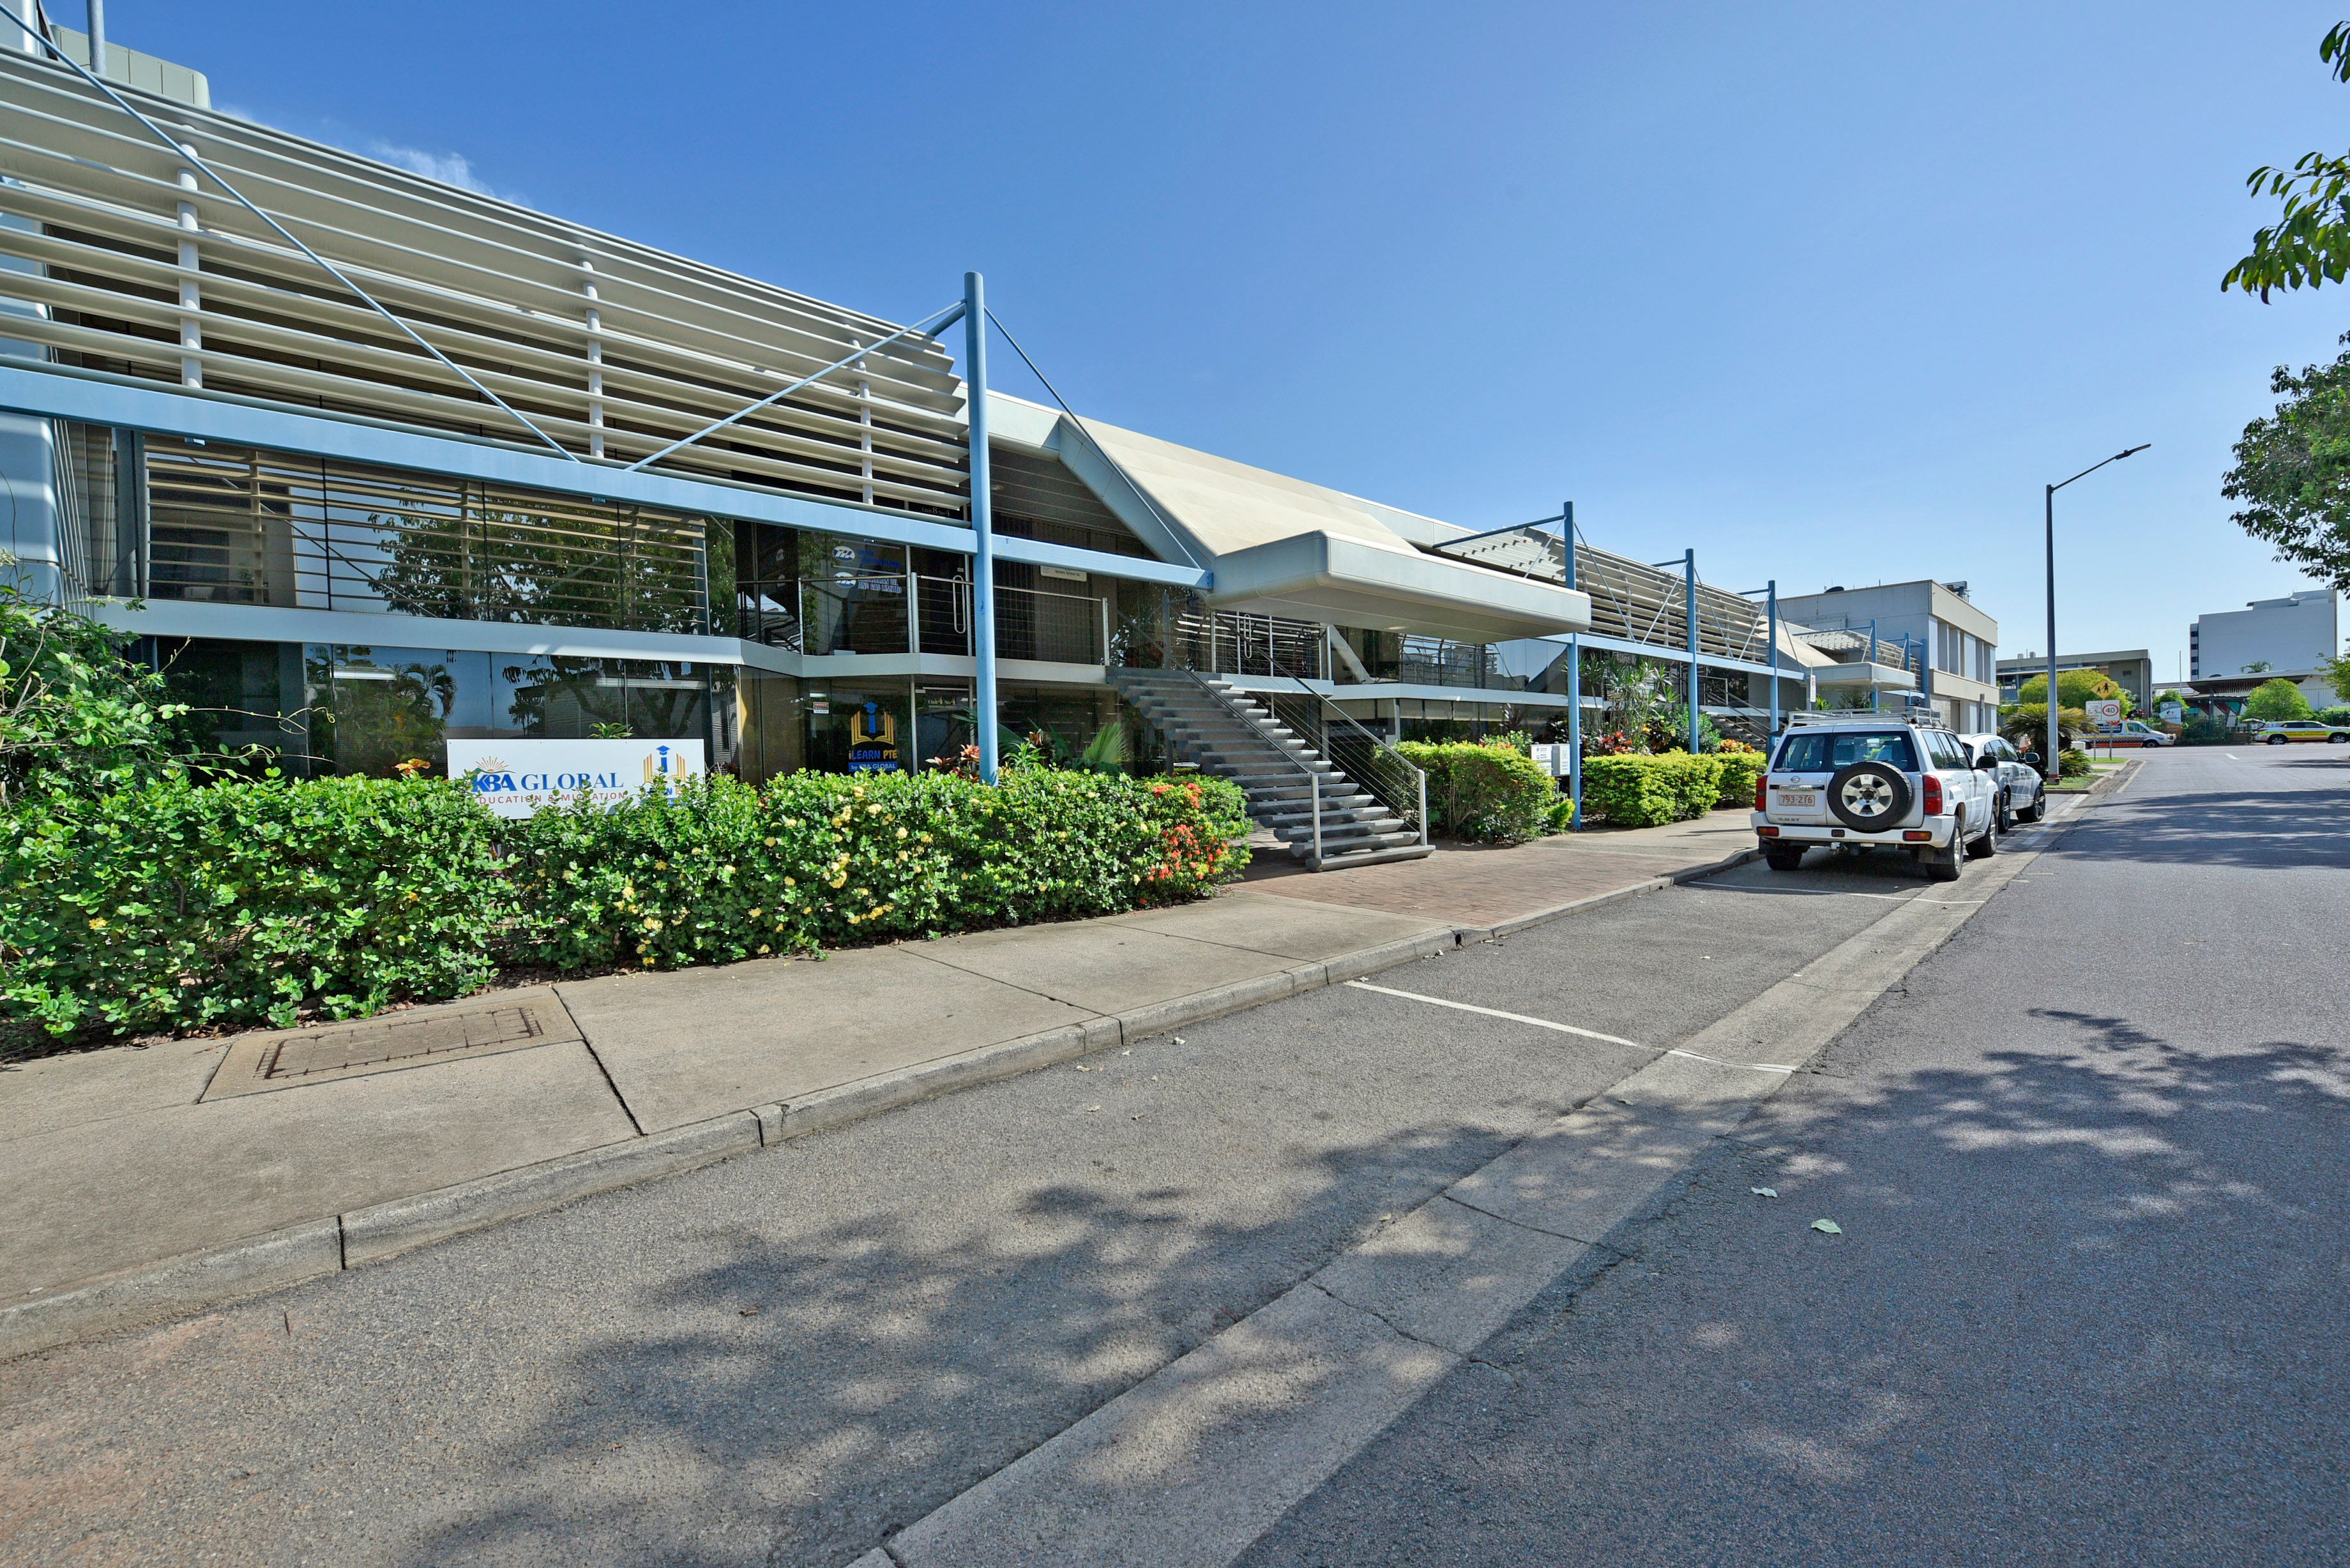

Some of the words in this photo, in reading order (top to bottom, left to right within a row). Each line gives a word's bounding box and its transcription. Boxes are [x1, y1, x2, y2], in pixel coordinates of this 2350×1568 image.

[932, 506, 938, 515] 8
[849, 750, 881, 760] iLEARN
[883, 750, 898, 760] PTE
[471, 773, 518, 792] KBA
[521, 772, 624, 791] GLOBAL
[480, 794, 542, 805] DUCATION
[548, 794, 555, 803] &
[1780, 795, 1813, 804] 793-216
